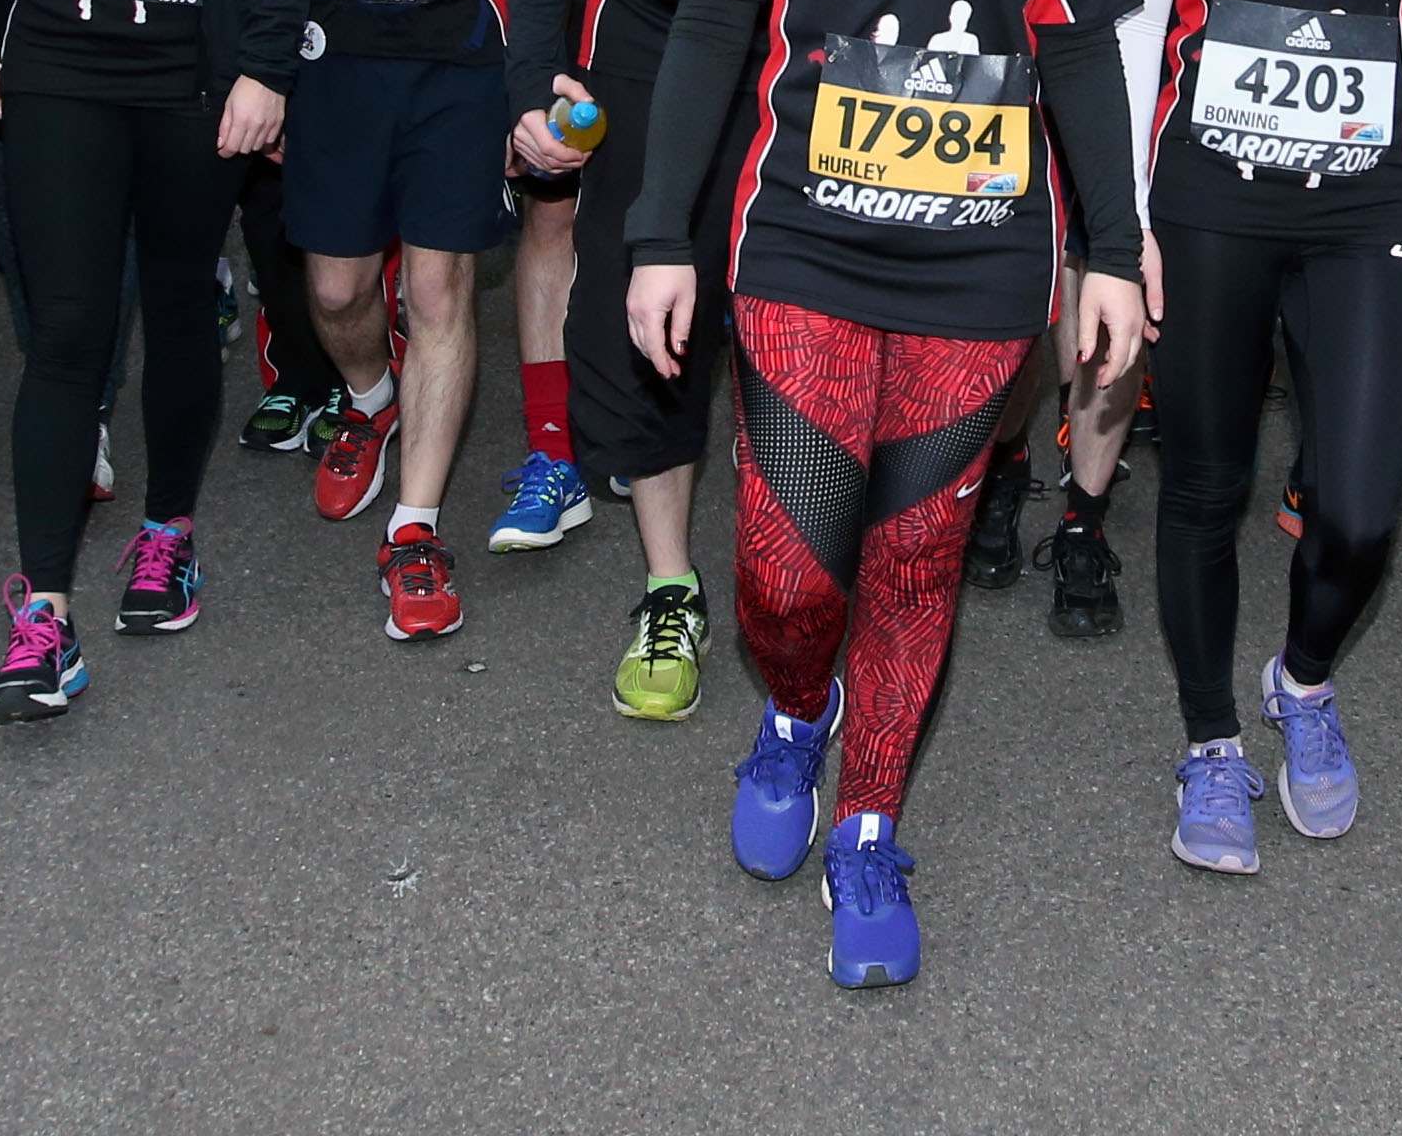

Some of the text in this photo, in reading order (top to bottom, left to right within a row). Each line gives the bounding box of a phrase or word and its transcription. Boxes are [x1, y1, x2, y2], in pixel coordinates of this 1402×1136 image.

[1285, 35, 1332, 51] adidas
[904, 79, 954, 95] adidas
[1234, 56, 1365, 115] 4203
[836, 96, 1006, 166] 17984
[1204, 104, 1280, 131] BONNING
[818, 153, 889, 182] HURLEY
[1200, 128, 1384, 173] CARDIFF 2016
[814, 178, 1014, 227] CARDIFF 2016
